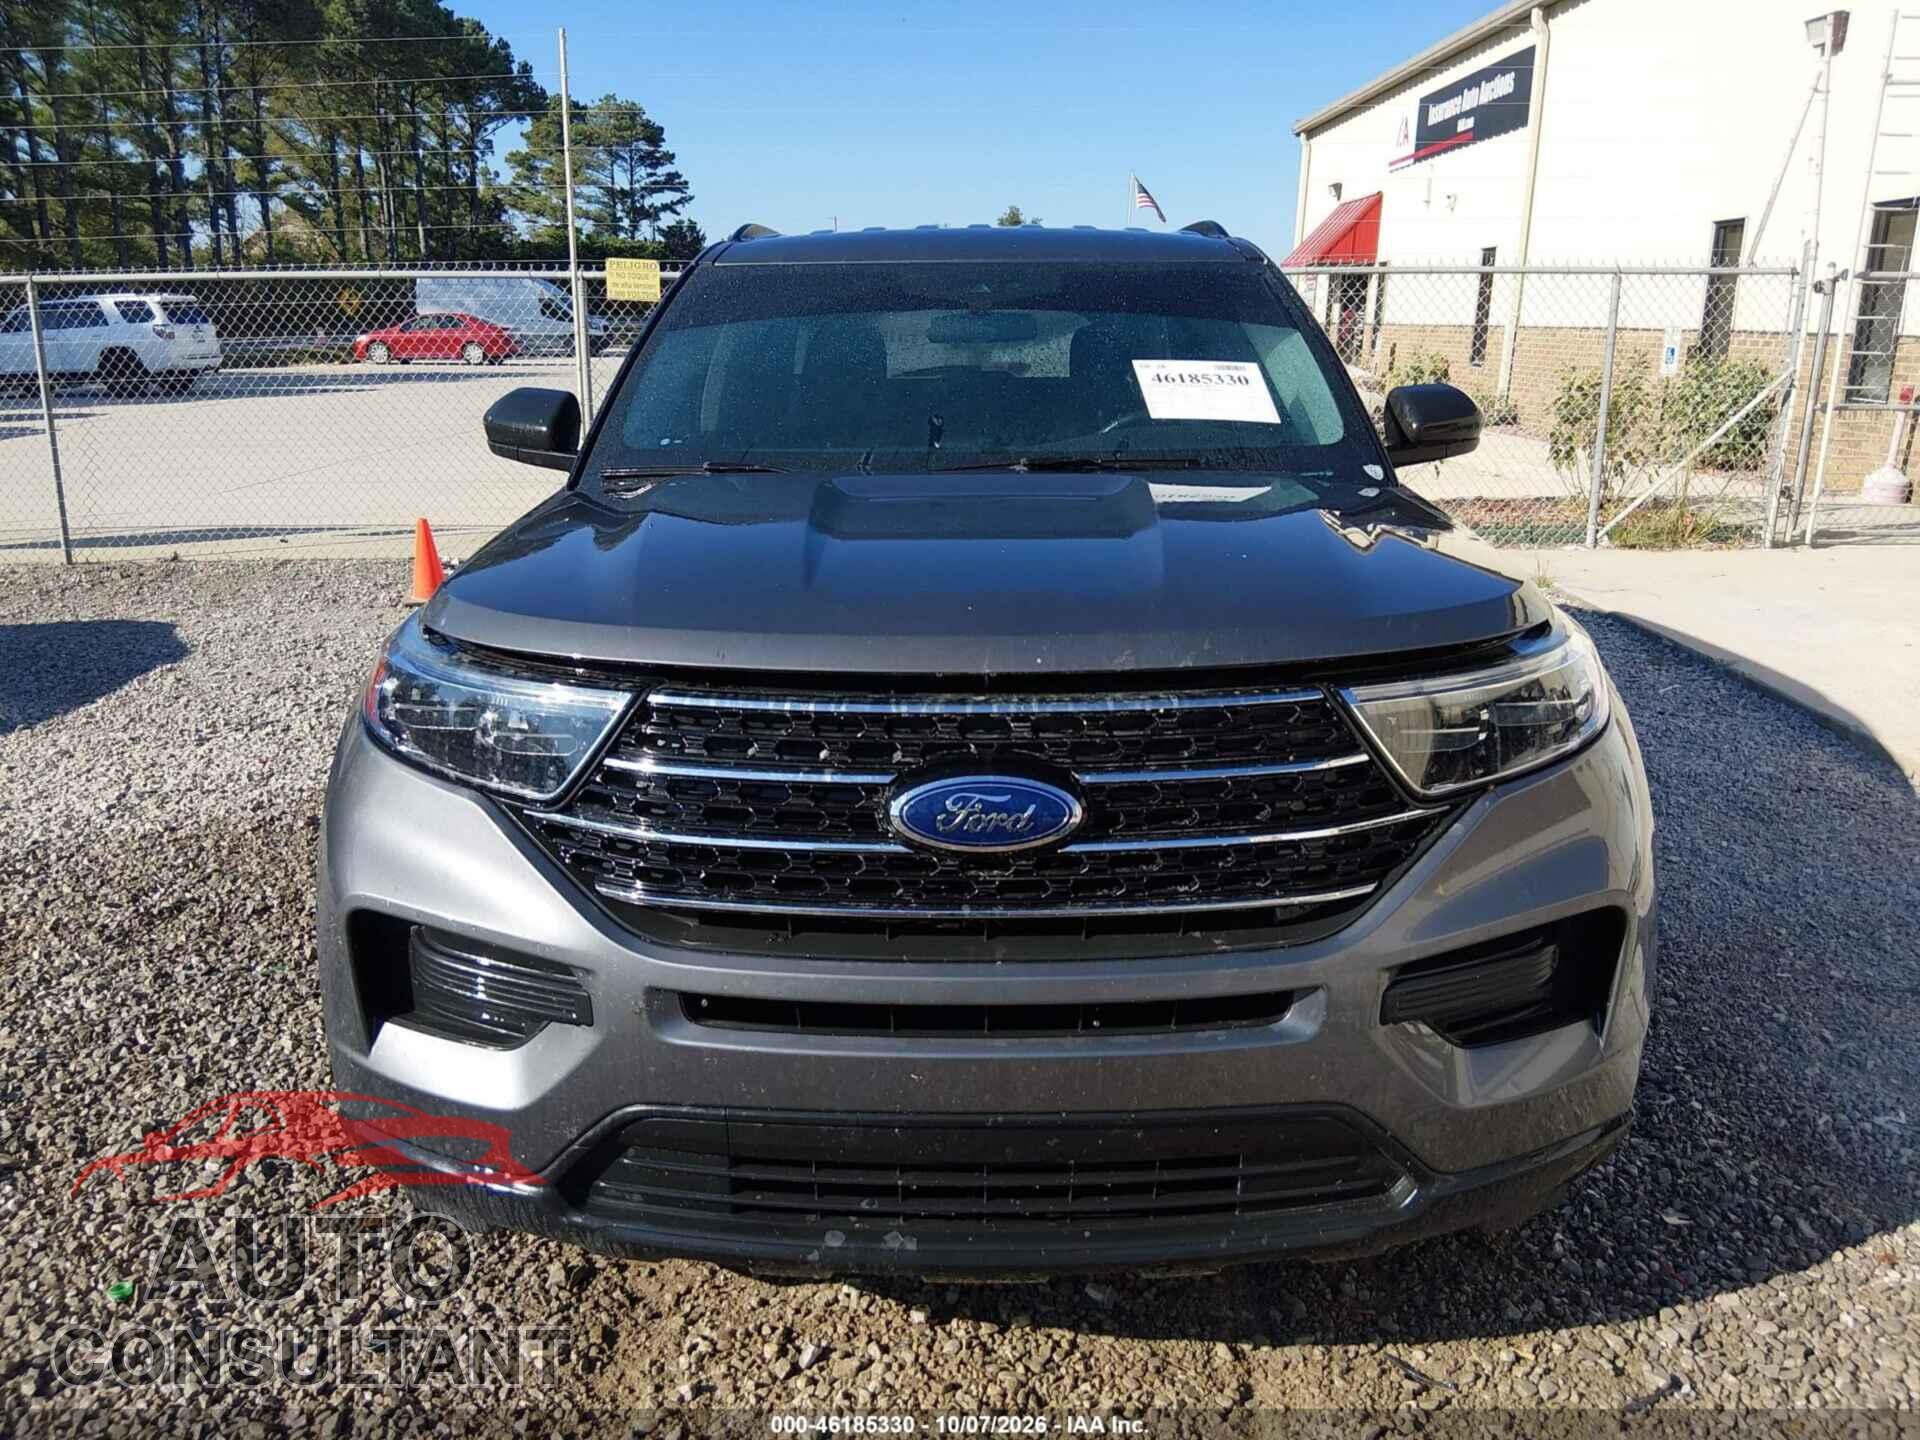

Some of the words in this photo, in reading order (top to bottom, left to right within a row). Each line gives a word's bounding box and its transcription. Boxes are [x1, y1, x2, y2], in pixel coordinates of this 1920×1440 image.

[1462, 87, 1479, 112] Auto
[609, 261, 657, 270] PELIGRO
[1151, 372, 1250, 387] 46185330
[936, 792, 1036, 833] Ford
